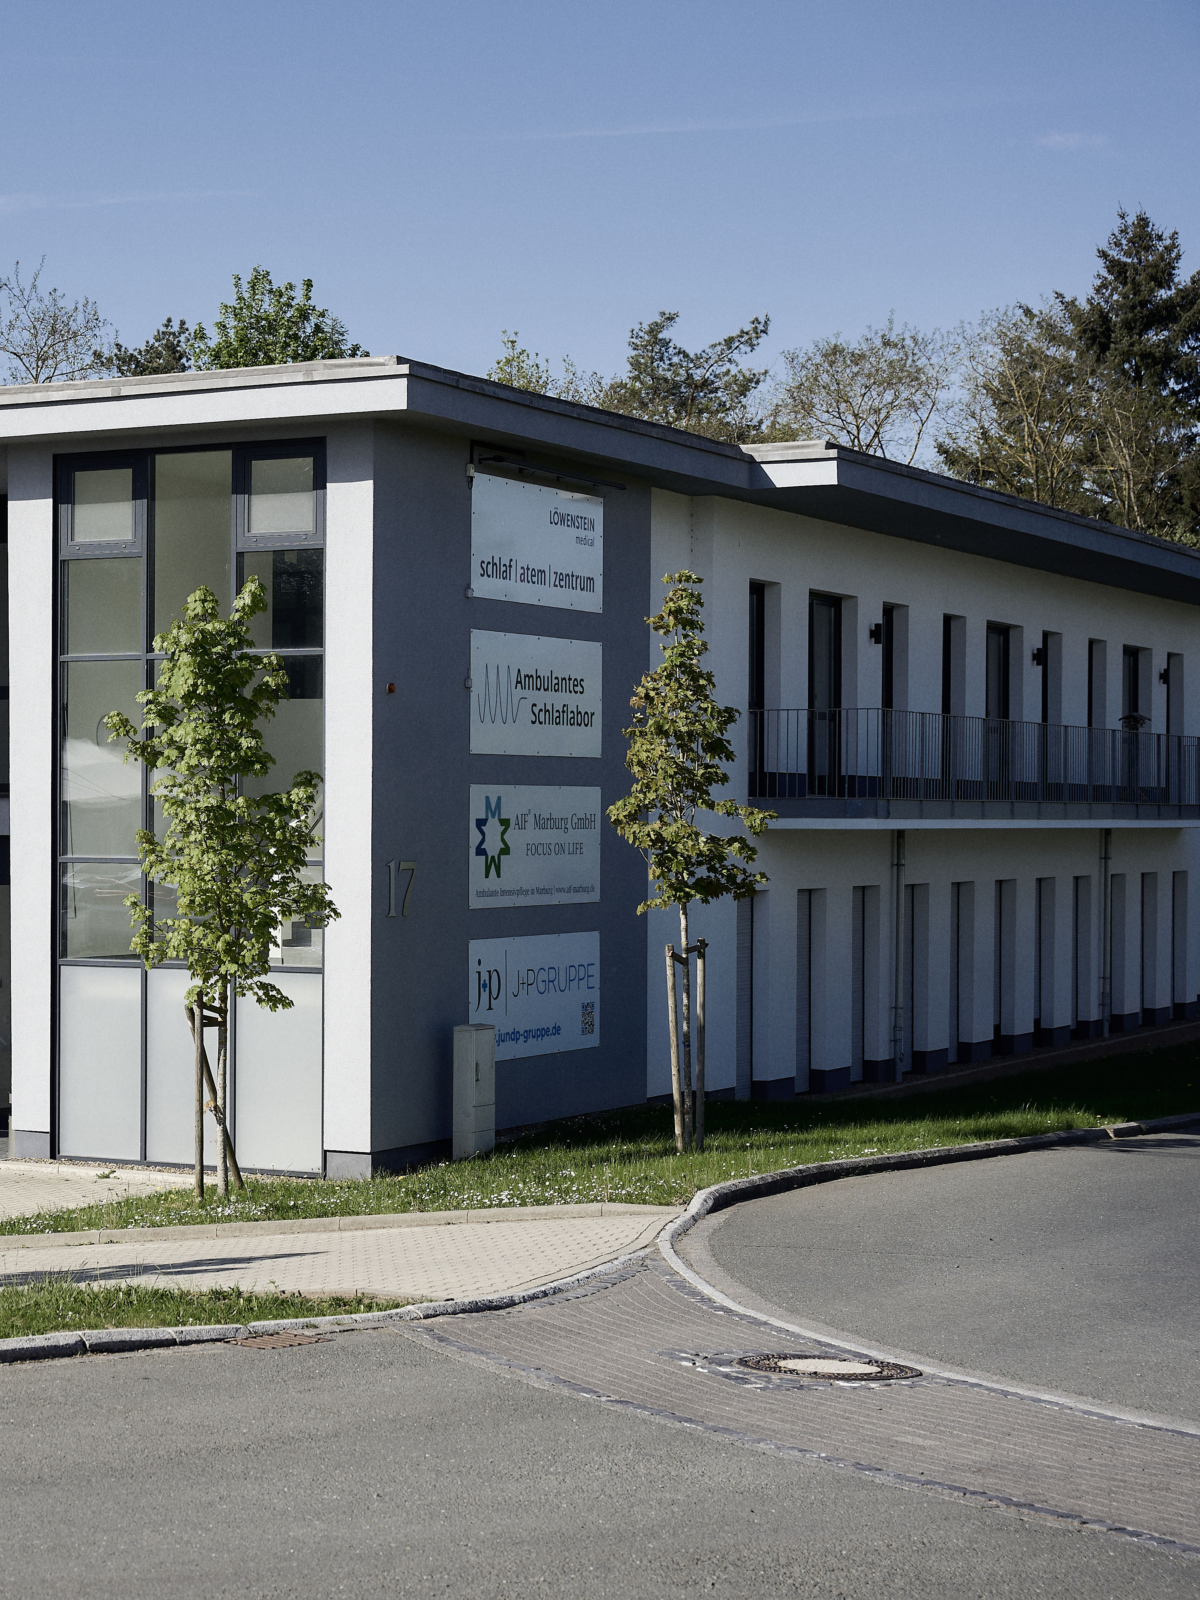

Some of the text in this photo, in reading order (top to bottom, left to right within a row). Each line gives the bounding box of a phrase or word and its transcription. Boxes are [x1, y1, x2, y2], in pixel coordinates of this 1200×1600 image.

[549, 506, 595, 532] LÖWENSTEIN
[575, 535, 595, 547] medical
[480, 555, 595, 593] schlaf atem zentrum
[515, 668, 585, 694] Ambulantes
[530, 702, 595, 727] Schlaflabor
[533, 813, 569, 834] Marburg
[571, 813, 596, 830] GmbH
[526, 842, 584, 856] FOCUS ON LIFE
[385, 859, 417, 918] 17
[494, 1022, 561, 1047] .jundp-gruppe.de
